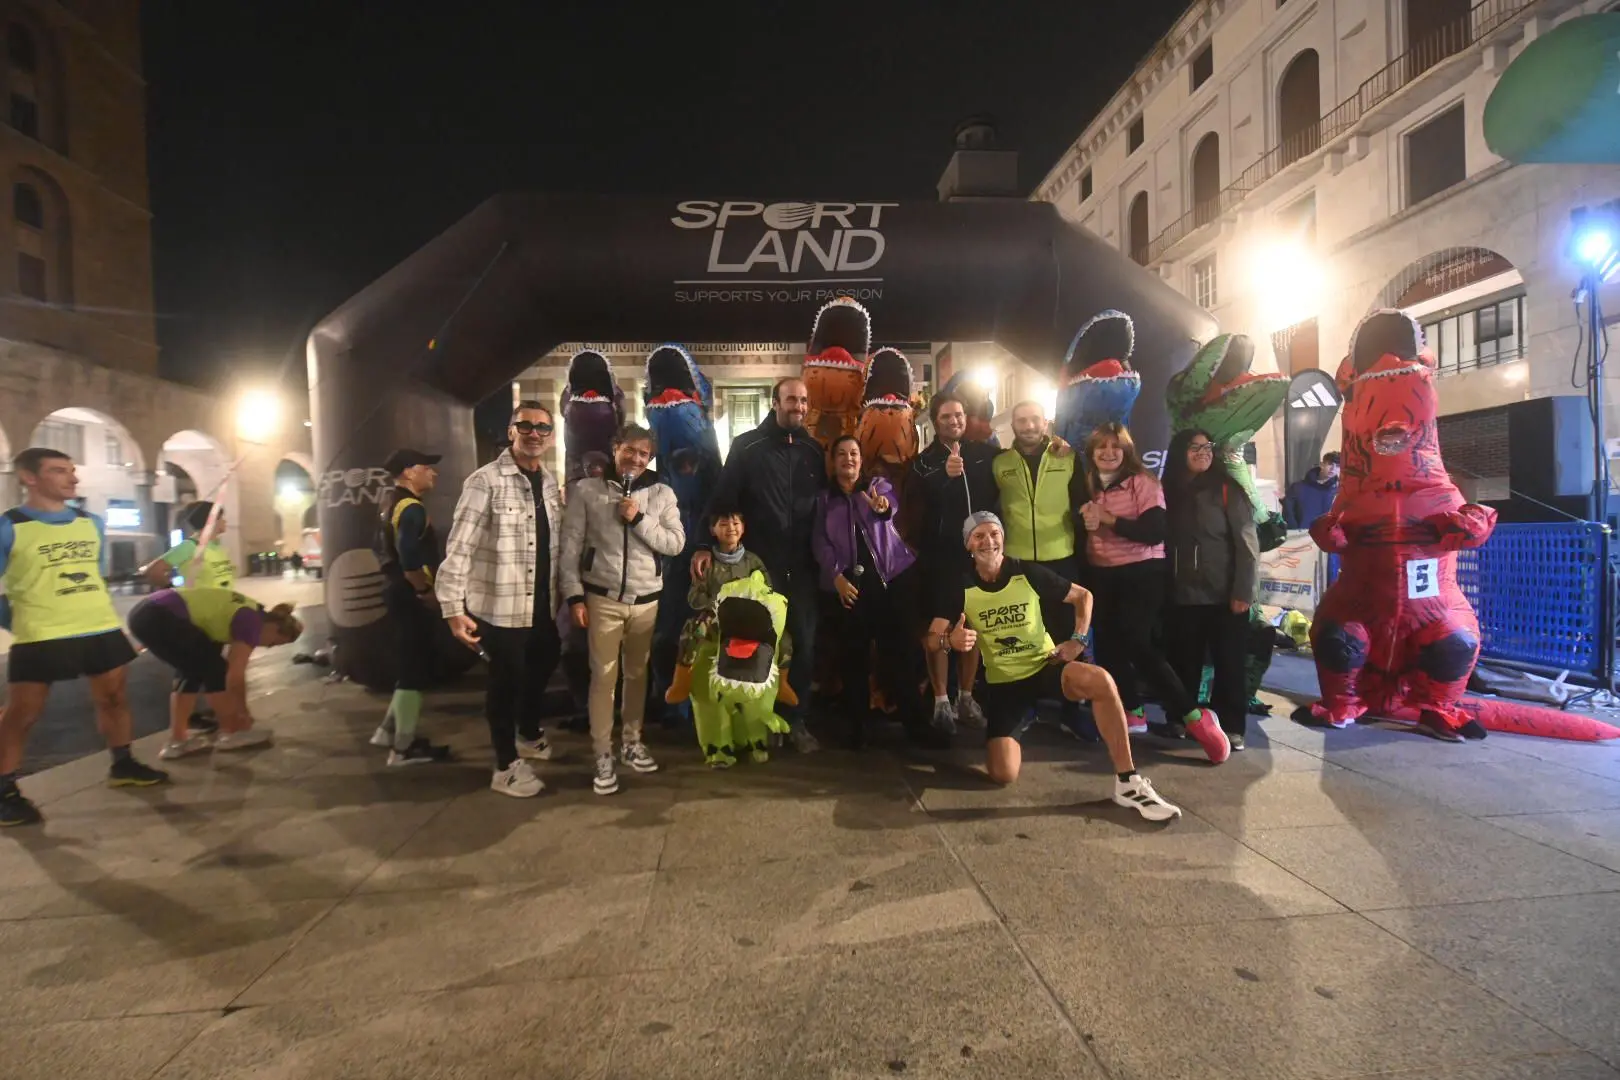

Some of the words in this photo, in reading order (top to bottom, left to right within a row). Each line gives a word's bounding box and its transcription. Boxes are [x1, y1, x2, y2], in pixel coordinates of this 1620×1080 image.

[671, 200, 900, 229] SPORT
[707, 229, 886, 273] LAND
[674, 289, 763, 302] SUPPORTS
[767, 289, 812, 302] YOUR
[816, 288, 884, 301] PASSION
[320, 467, 392, 492] SPOR
[1416, 564, 1429, 593] 5
[985, 613, 1026, 628] LAND
